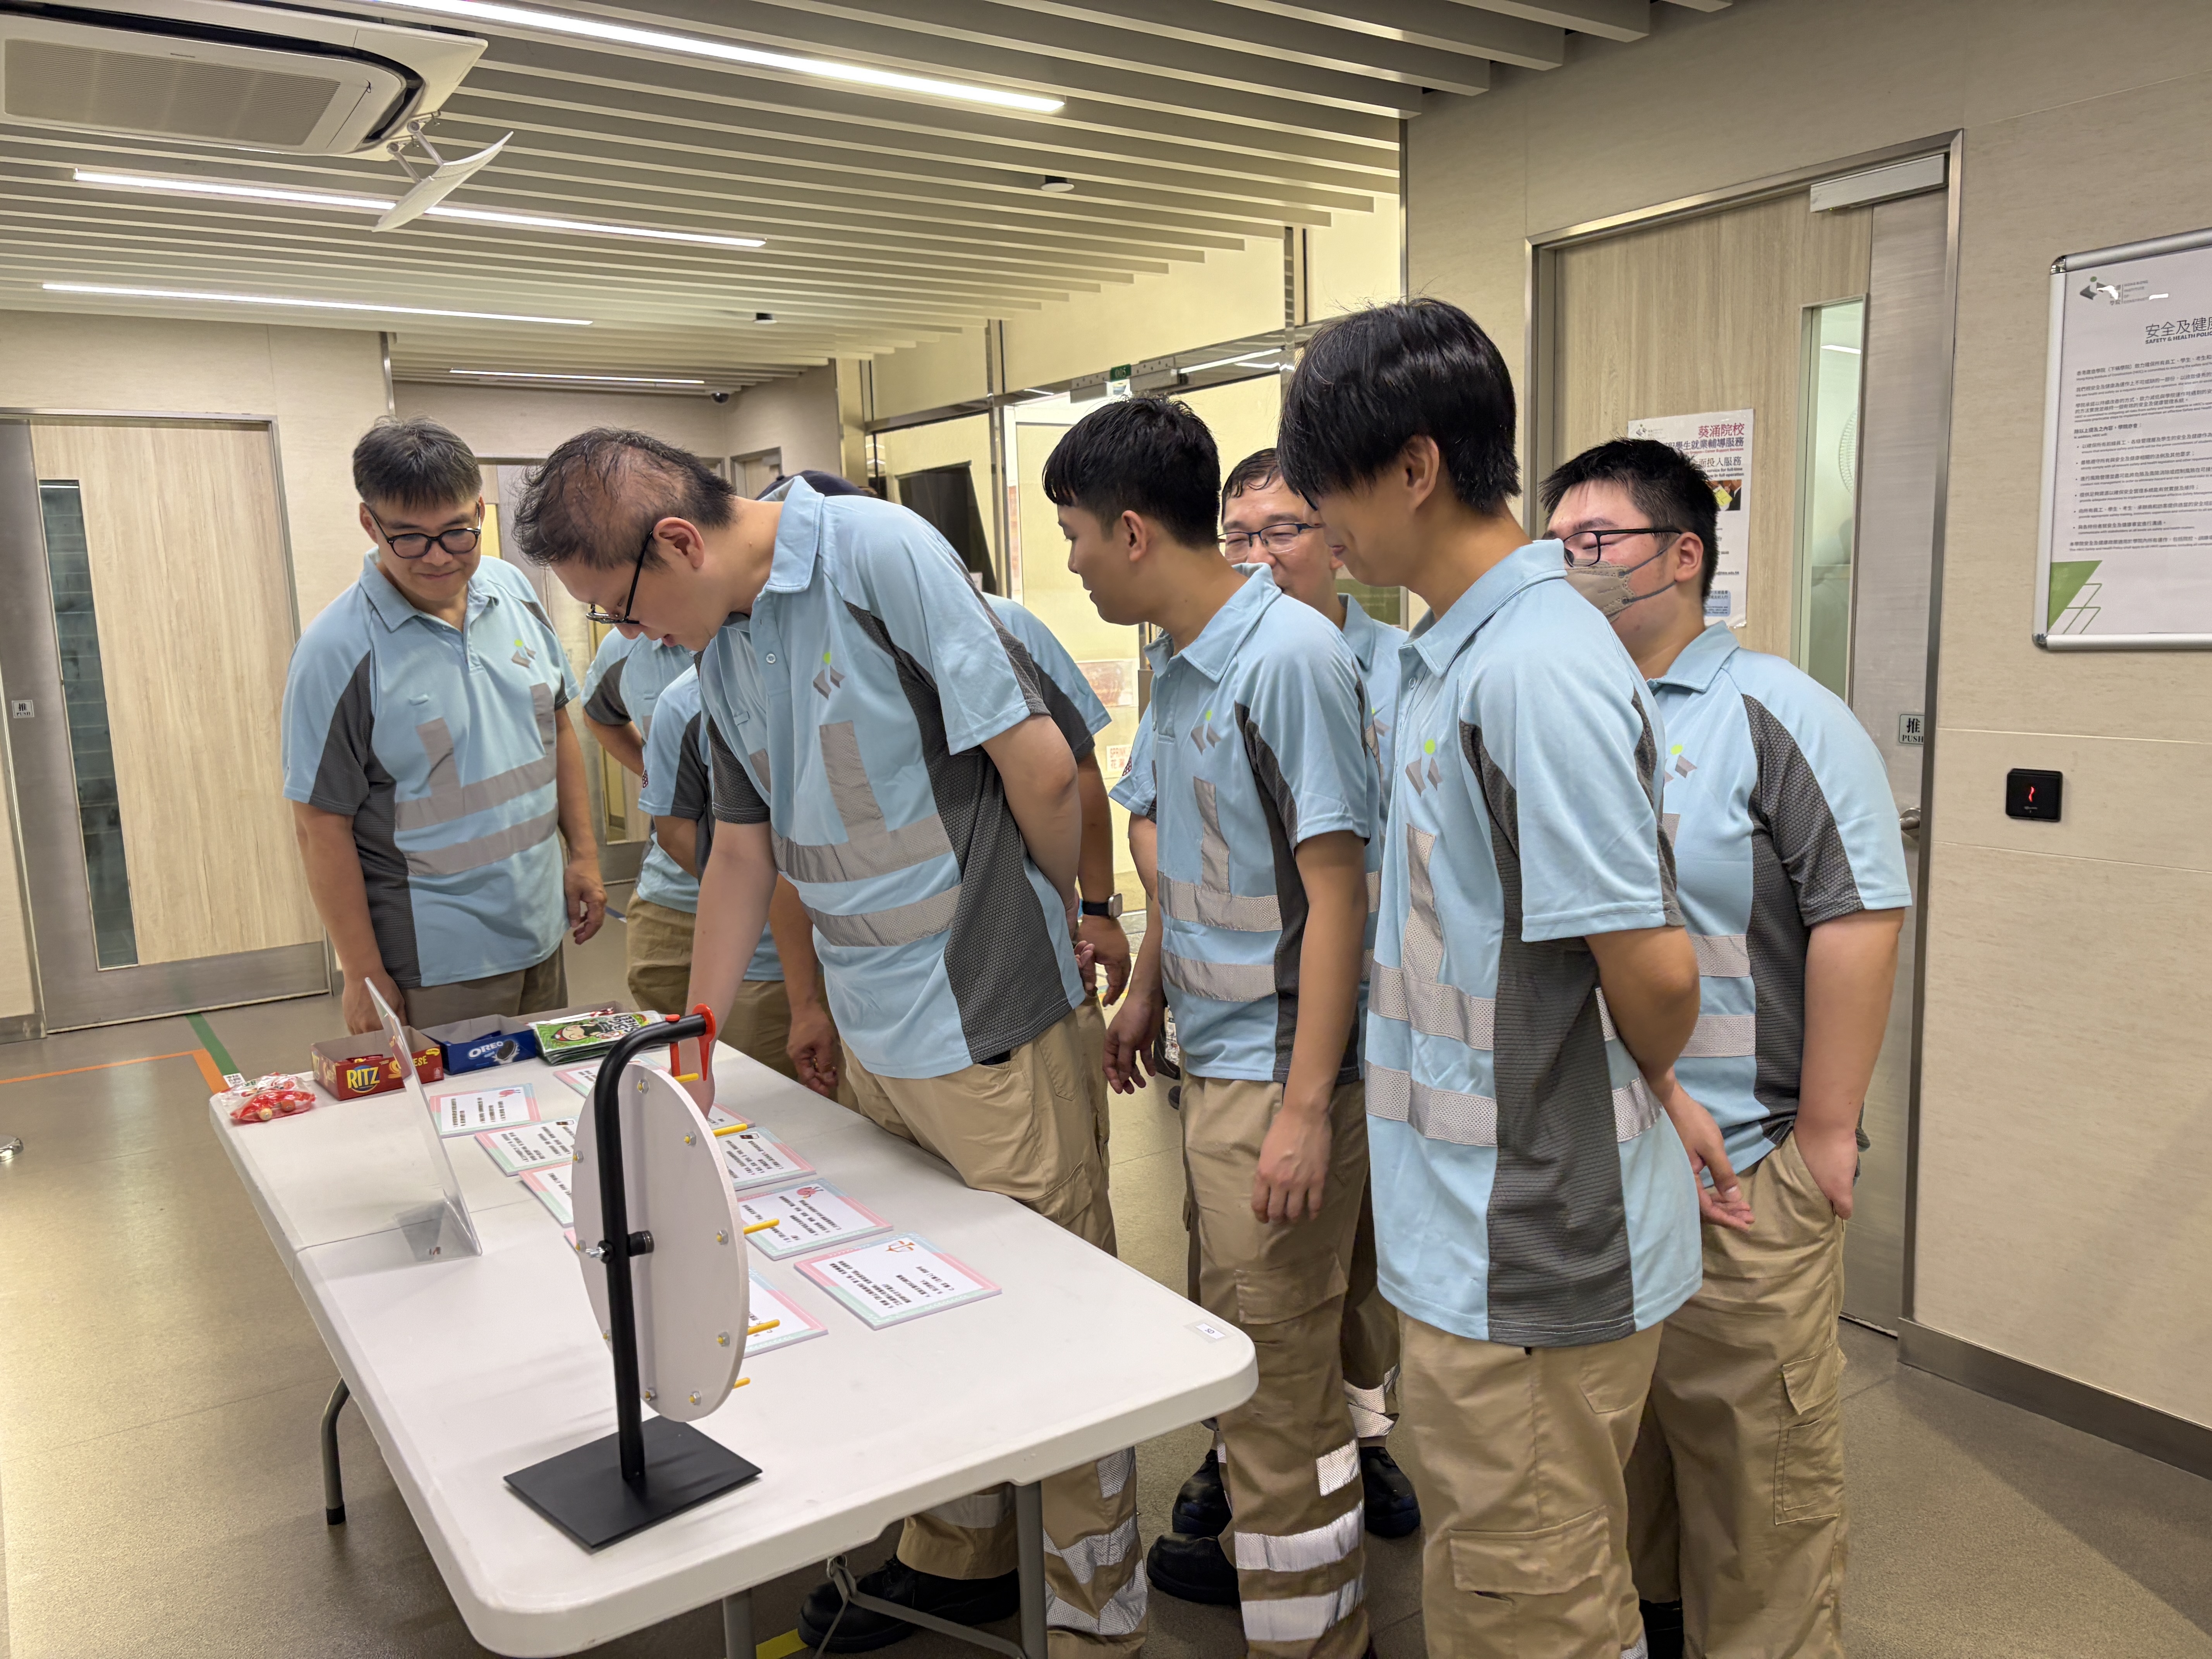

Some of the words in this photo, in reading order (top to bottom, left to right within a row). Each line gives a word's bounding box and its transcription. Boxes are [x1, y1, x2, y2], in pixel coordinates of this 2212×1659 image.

[1698, 422, 1745, 439] 葵涌院校
[1906, 718, 1920, 733] 推
[469, 1041, 503, 1058] OREO
[413, 1055, 428, 1066] ESE
[346, 1067, 380, 1089] RITZ
